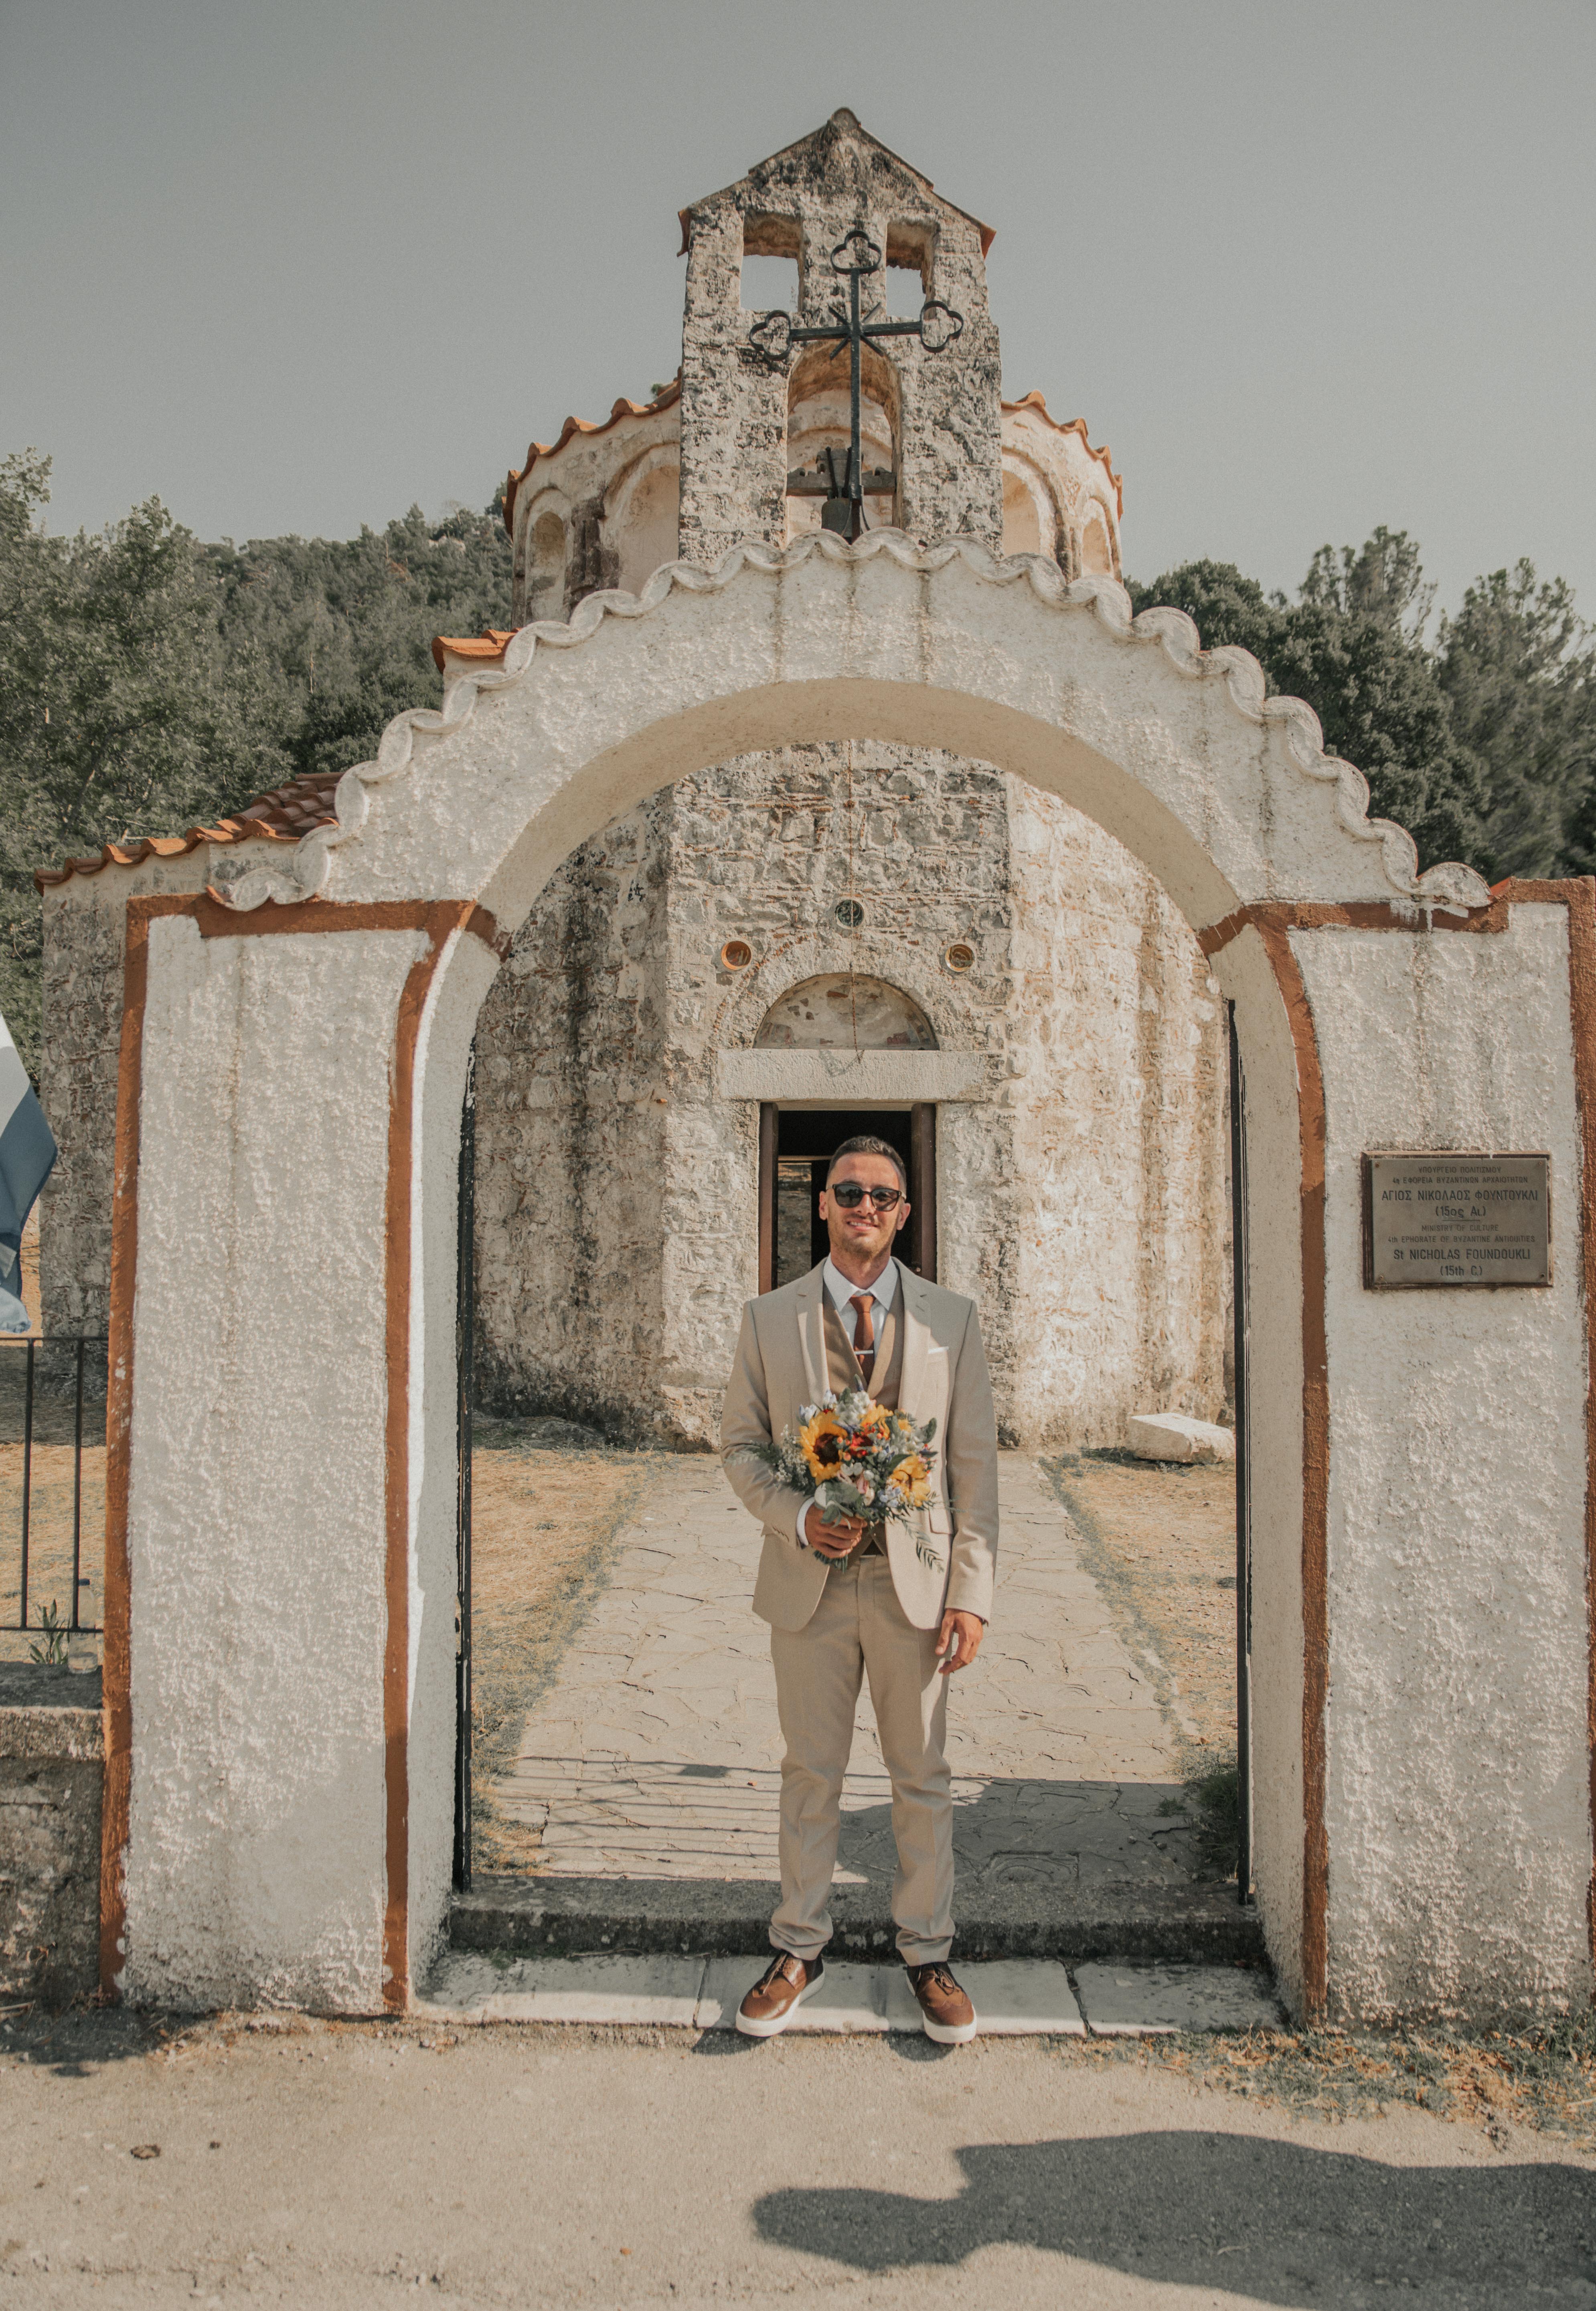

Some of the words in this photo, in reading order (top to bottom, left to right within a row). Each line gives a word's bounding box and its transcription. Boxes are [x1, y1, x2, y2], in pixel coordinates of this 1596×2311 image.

[1381, 1190, 1412, 1201] ΑΓΙΟΣ
[1418, 1190, 1470, 1201] ΝΙΚΟΛΑΟΣ
[1474, 1190, 1538, 1201] ΦΟΥΝΤΟΥΚΛΙ
[1393, 1250, 1404, 1260] St
[1410, 1249, 1460, 1260] NICHOLAS
[1466, 1249, 1530, 1260] FOUNDOUKLI
[1440, 1266, 1464, 1276] (15th
